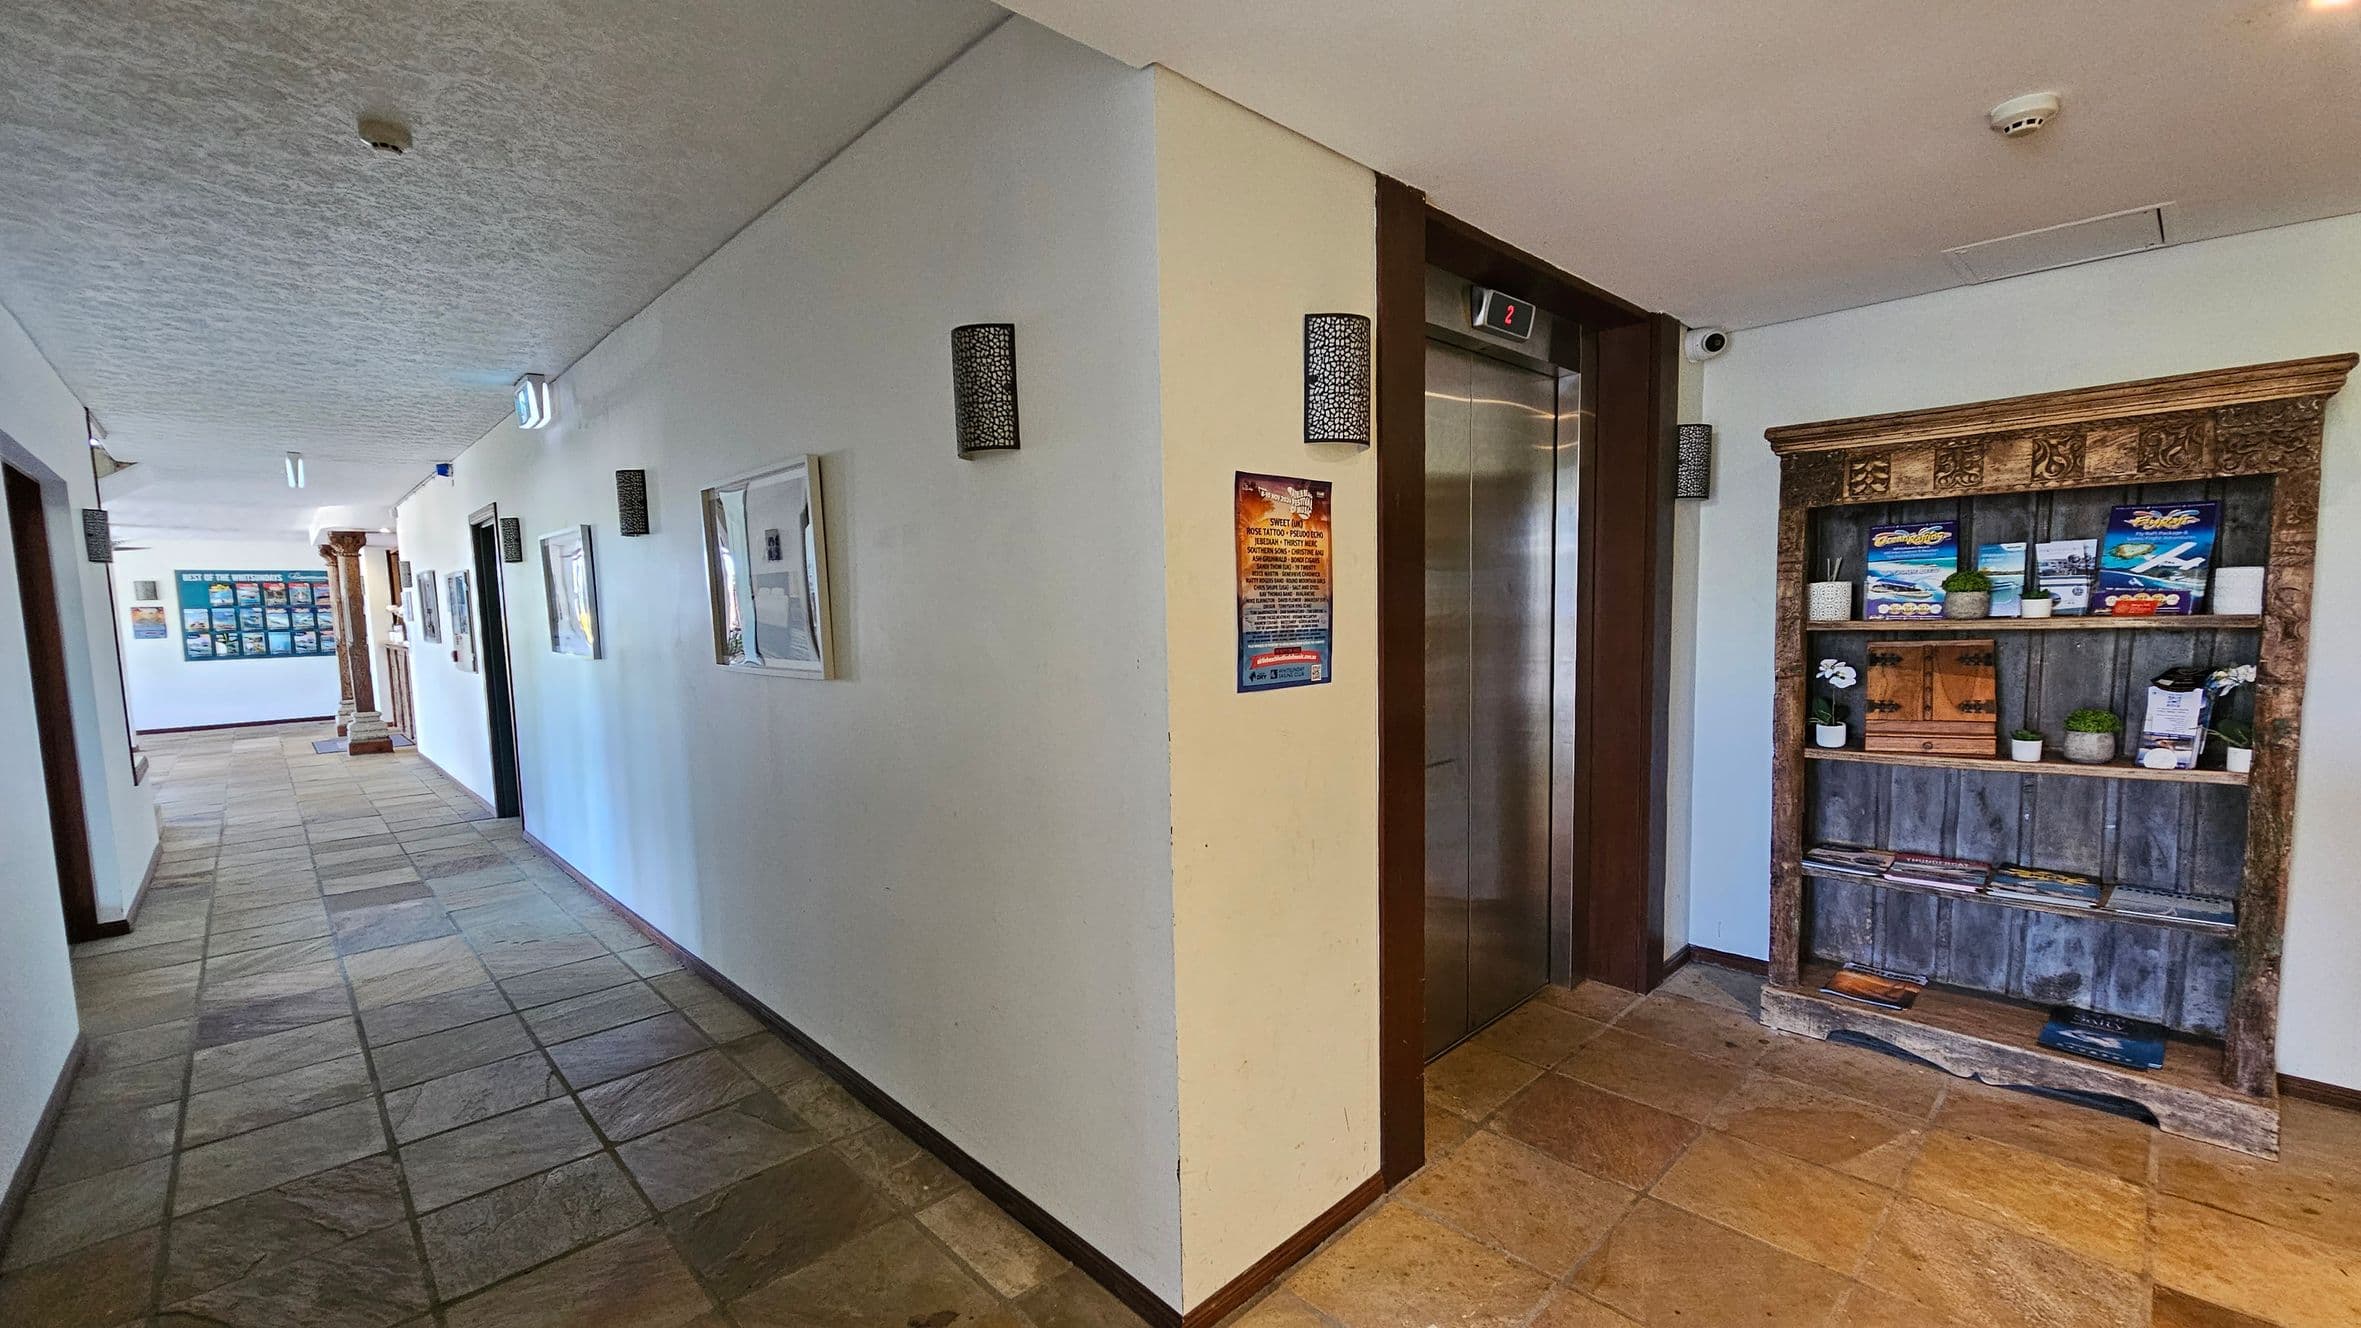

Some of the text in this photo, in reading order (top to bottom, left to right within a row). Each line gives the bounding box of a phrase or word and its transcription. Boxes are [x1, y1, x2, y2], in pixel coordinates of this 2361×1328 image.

[1504, 304, 1515, 326] 2
[1270, 518, 1303, 528] SWEET (UK)
[1263, 528, 1285, 536] TATTOO
[1290, 530, 1310, 538] PSEUDO
[182, 574, 202, 582] BEST
